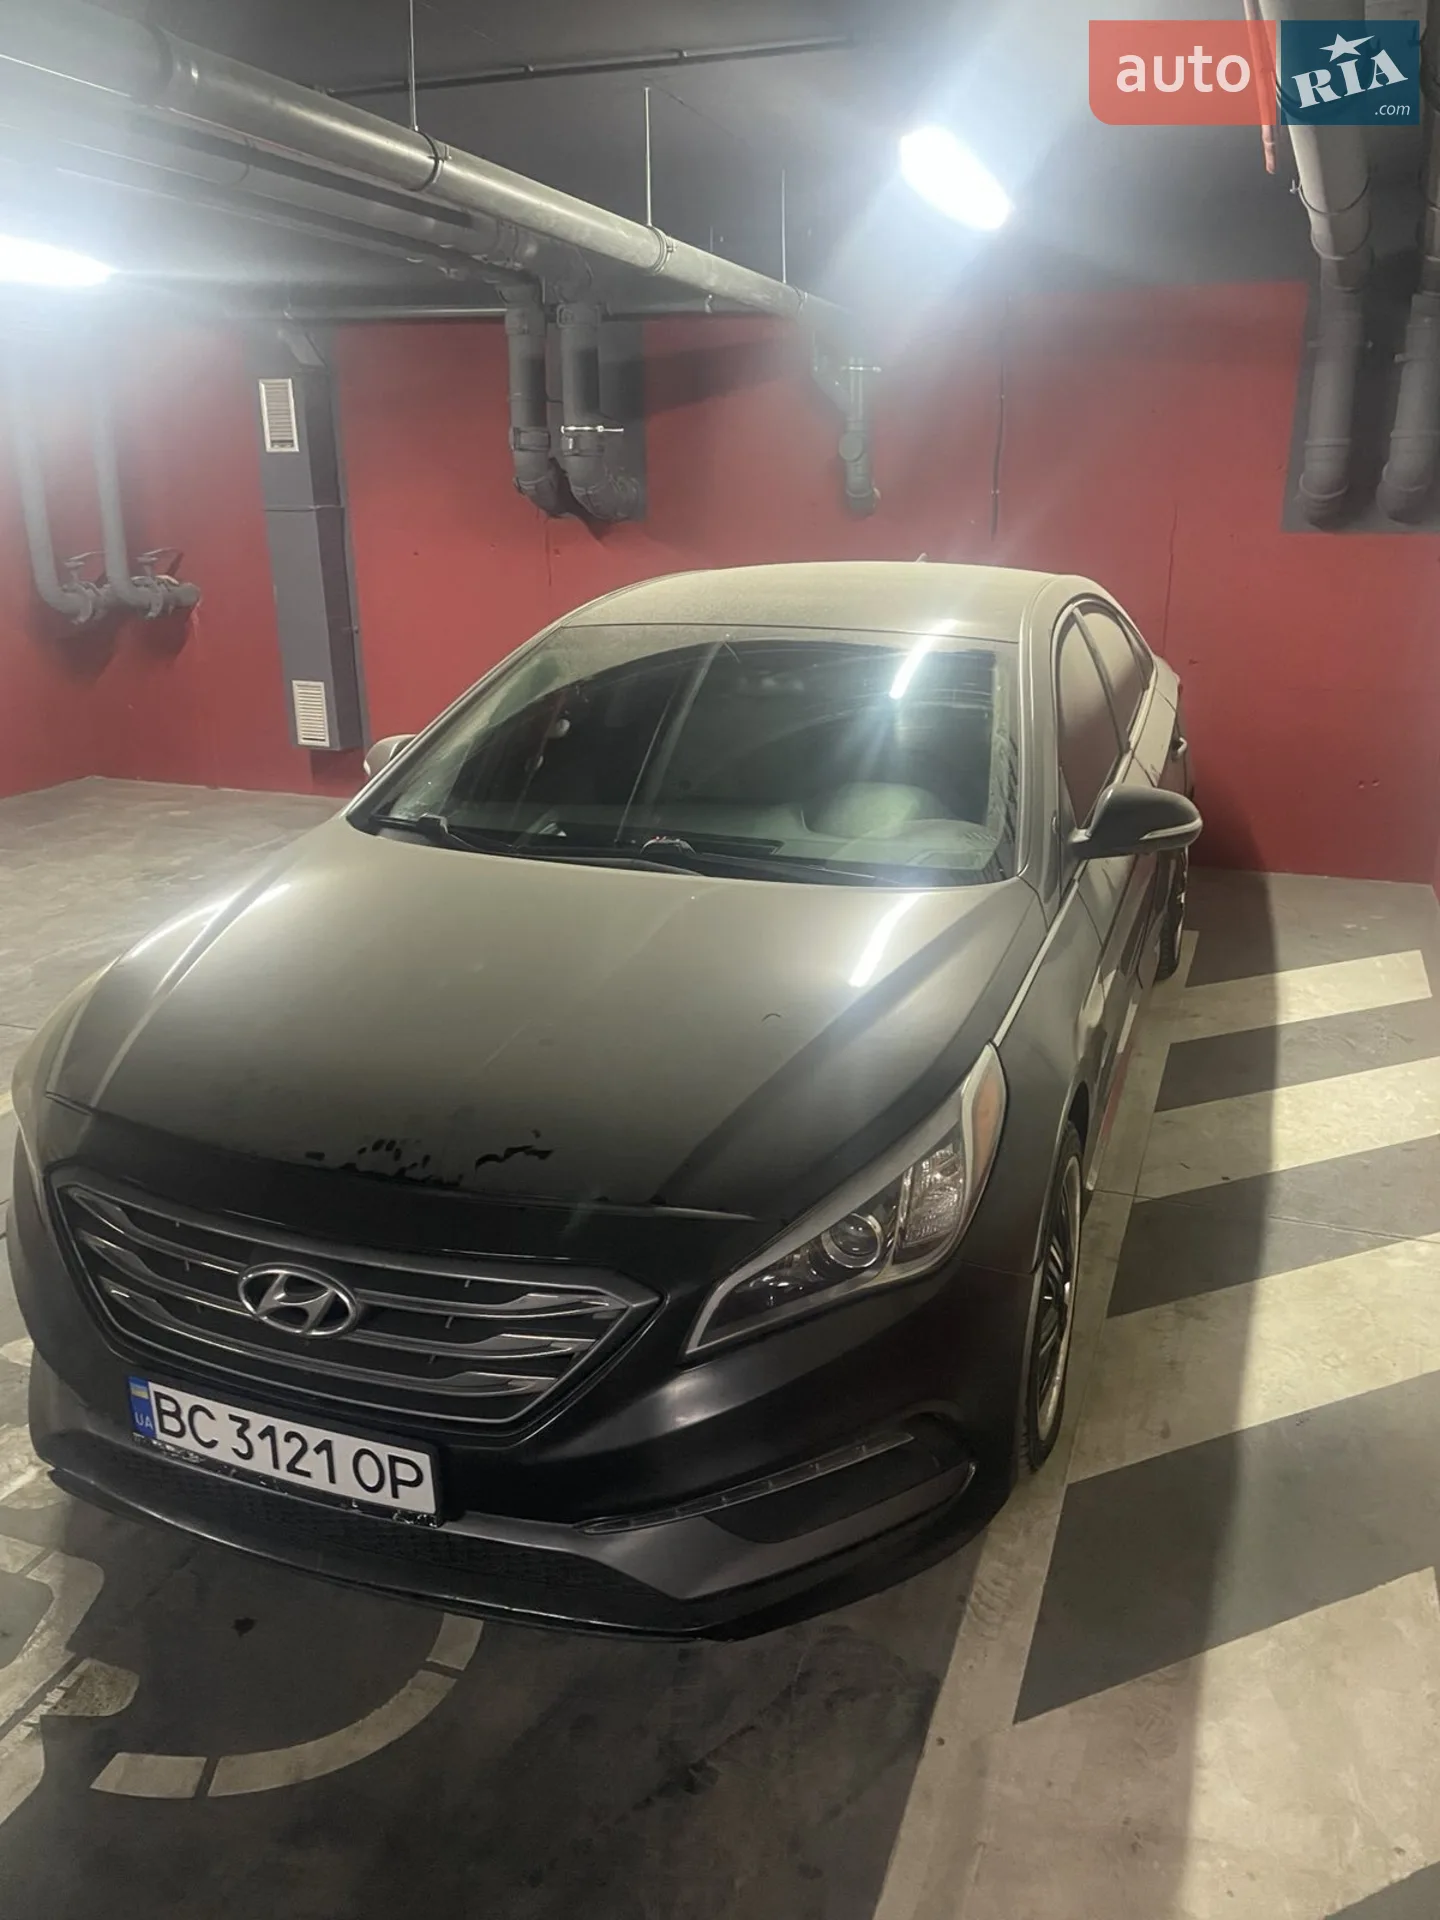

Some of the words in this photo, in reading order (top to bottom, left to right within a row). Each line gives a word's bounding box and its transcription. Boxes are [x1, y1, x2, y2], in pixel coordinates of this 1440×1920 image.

[134, 1412, 154, 1430] UA
[153, 1391, 218, 1448] BC
[227, 1413, 336, 1484] 3121
[352, 1448, 424, 1499] OP
